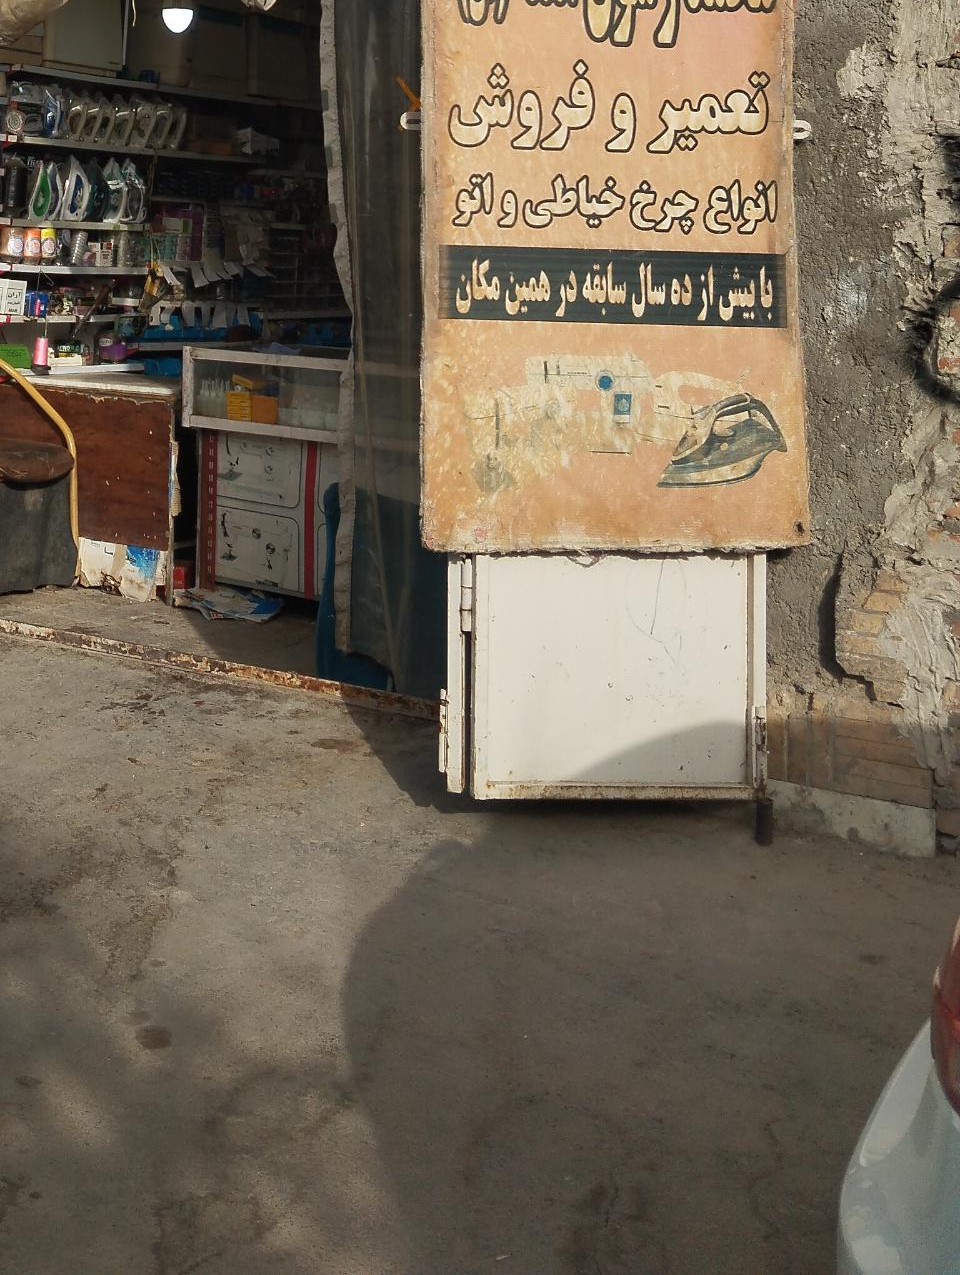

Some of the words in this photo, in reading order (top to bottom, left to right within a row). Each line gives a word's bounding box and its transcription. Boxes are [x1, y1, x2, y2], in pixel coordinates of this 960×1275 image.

[448, 59, 595, 152] فروش
[604, 92, 637, 153] و
[646, 70, 771, 154] تعمیر
[452, 172, 494, 227] اتو
[497, 189, 518, 228] و
[522, 174, 626, 229] خیاطی
[629, 179, 699, 235] چرخ
[703, 179, 778, 235] انواع
[455, 256, 500, 314] مکان
[505, 270, 550, 315] همین
[555, 270, 578, 317] در
[582, 261, 627, 317] سابقه
[632, 262, 666, 318] سال
[670, 273, 691, 306] ده
[697, 263, 714, 321] از
[718, 266, 755, 322] بیش
[759, 265, 774, 321] با
